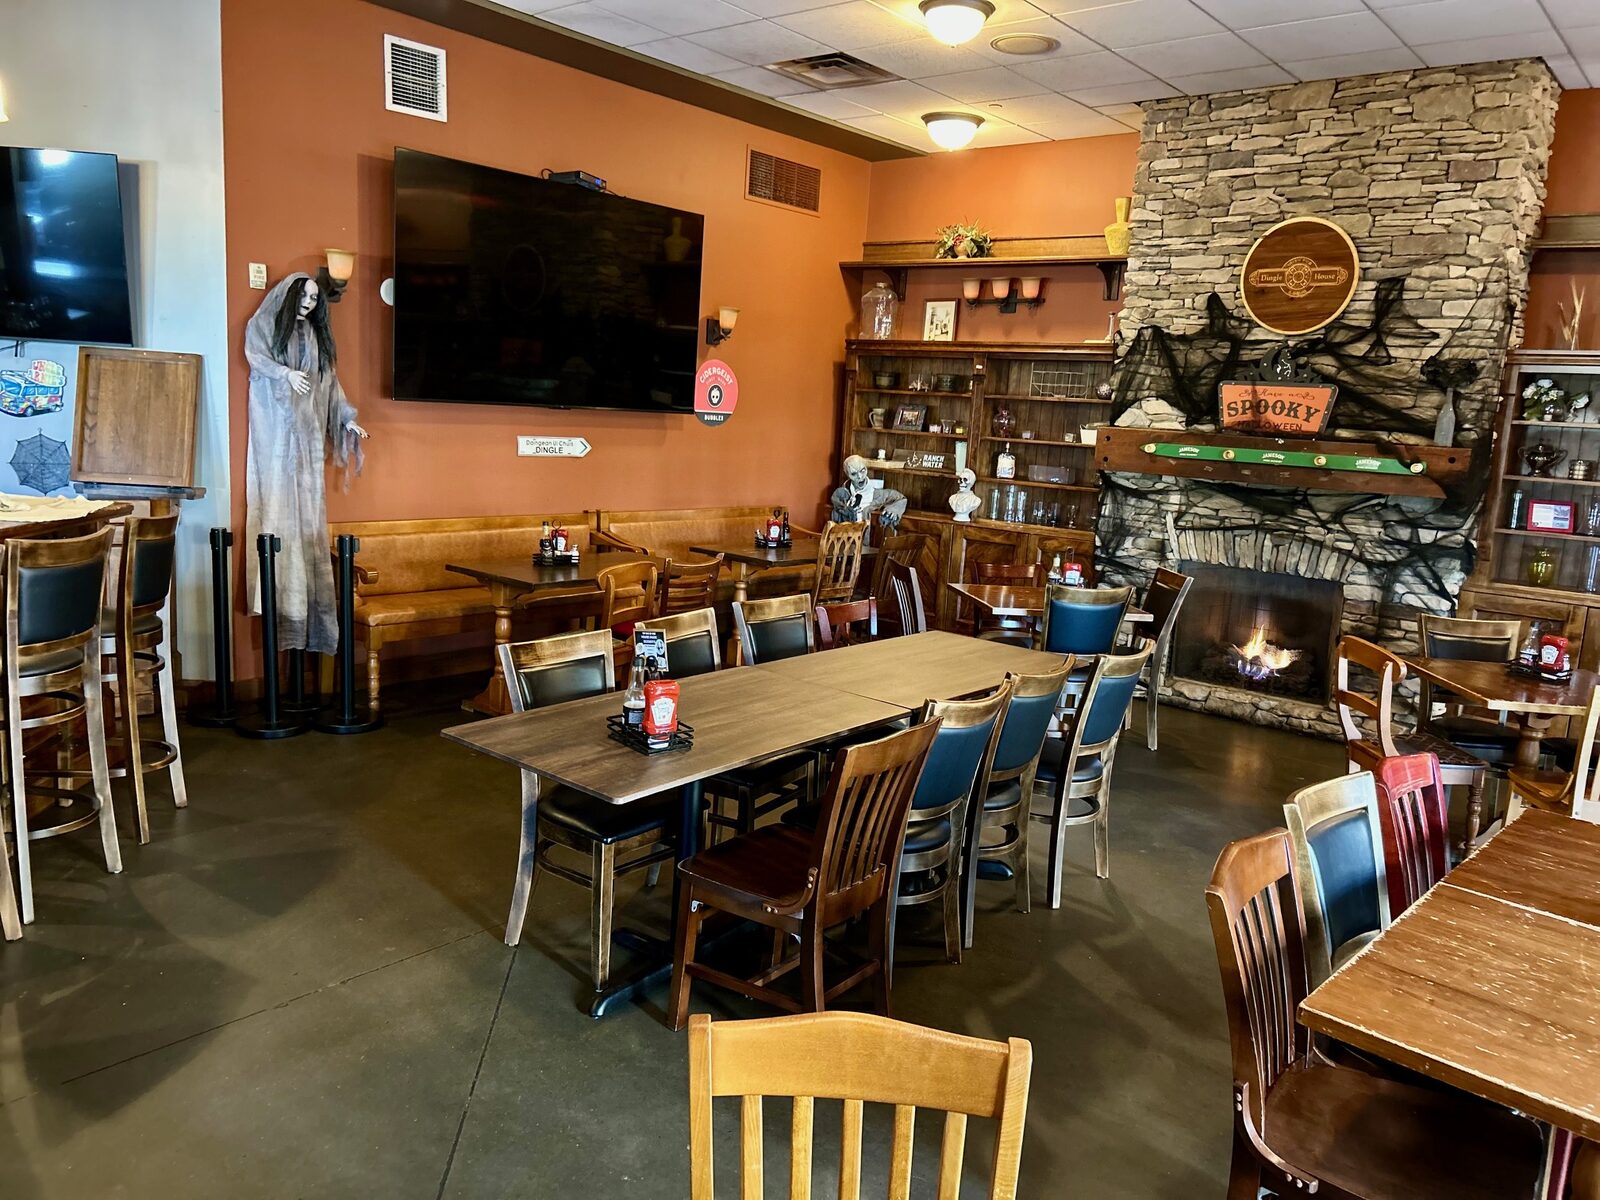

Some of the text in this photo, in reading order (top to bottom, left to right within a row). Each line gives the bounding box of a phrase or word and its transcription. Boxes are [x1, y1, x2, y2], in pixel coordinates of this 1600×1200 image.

[699, 367, 734, 385] CIDERGEIST
[1226, 398, 1321, 423] SPOOKY
[535, 446, 564, 454] DINGLE
[923, 454, 945, 462] RANCH
[1262, 452, 1285, 460] JAMESON
[922, 461, 944, 469] WATER
